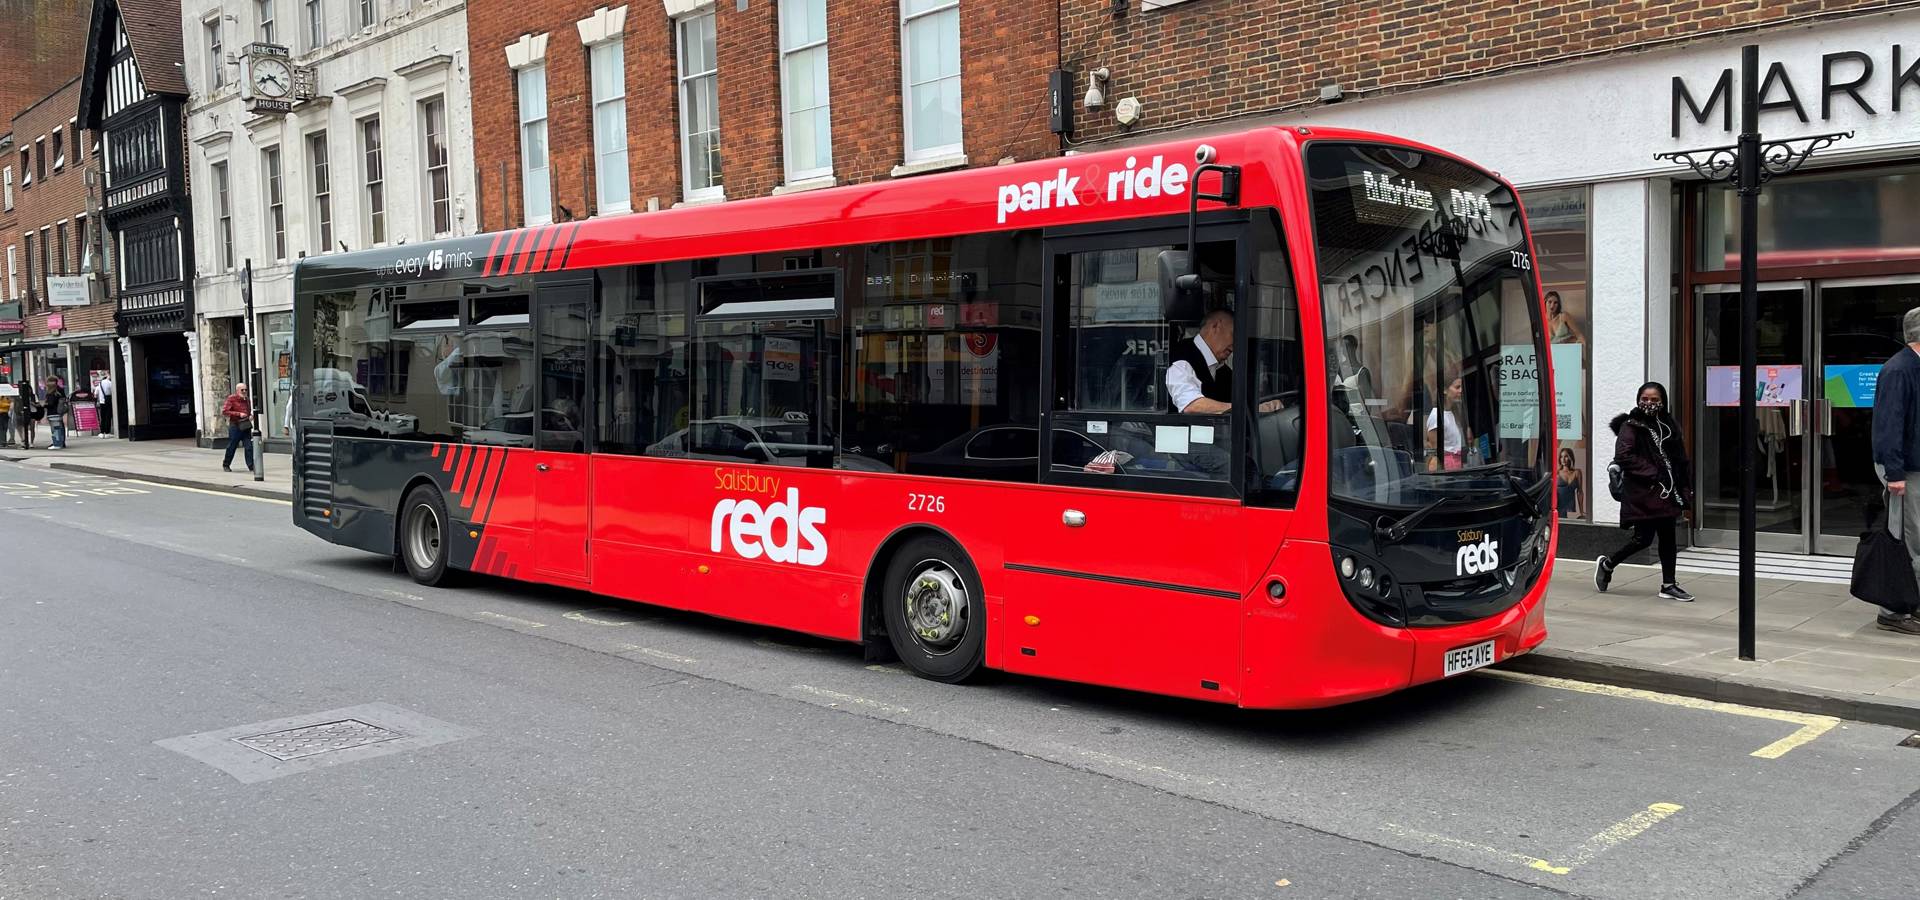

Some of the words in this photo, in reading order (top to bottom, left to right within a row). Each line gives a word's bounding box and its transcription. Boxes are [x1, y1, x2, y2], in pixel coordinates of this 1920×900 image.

[253, 45, 288, 56] ELECTRIC
[258, 100, 289, 110] HOUSE
[1671, 44, 1920, 138] MARK
[997, 167, 1080, 223] park
[1107, 156, 1189, 201] ride
[395, 256, 425, 277] every
[427, 249, 443, 271] 15
[445, 248, 473, 269] mins
[1510, 250, 1531, 270] 2726
[1511, 369, 1539, 380] BAC
[714, 467, 780, 498] Salisbury
[908, 493, 945, 513] 2726
[710, 487, 828, 567] reds
[1457, 530, 1484, 543] Salisbury
[1456, 534, 1499, 576] reds
[1447, 648, 1473, 672] HF65
[1475, 643, 1491, 666] AYE
